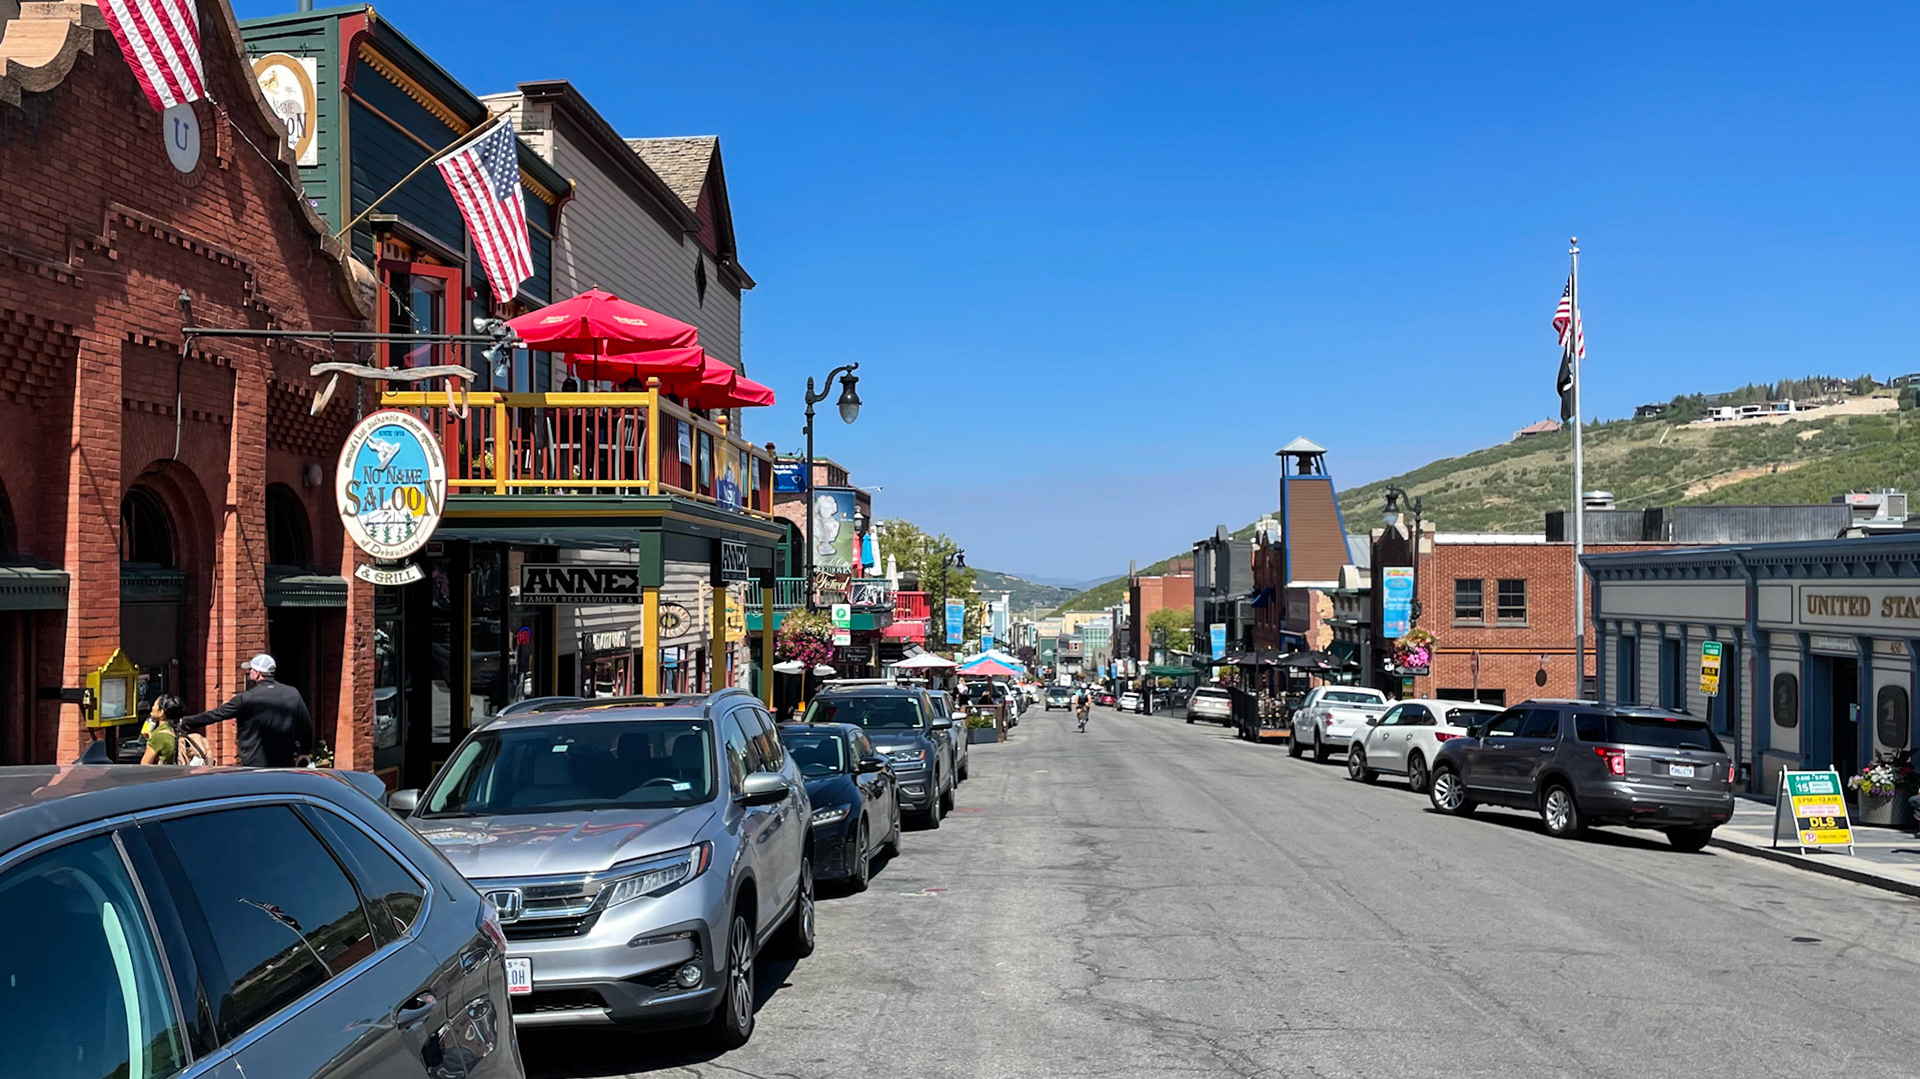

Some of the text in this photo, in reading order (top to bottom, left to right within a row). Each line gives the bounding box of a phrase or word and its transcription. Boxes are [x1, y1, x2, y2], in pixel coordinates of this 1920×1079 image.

[173, 117, 190, 151] U
[385, 465, 424, 485] NAME
[342, 479, 442, 518] SALOON
[361, 568, 416, 583] & GRILL
[523, 568, 639, 594] ANNEX
[1806, 594, 1871, 617] UNITED
[1796, 782, 1809, 792] 15
[1809, 816, 1836, 828] DLS
